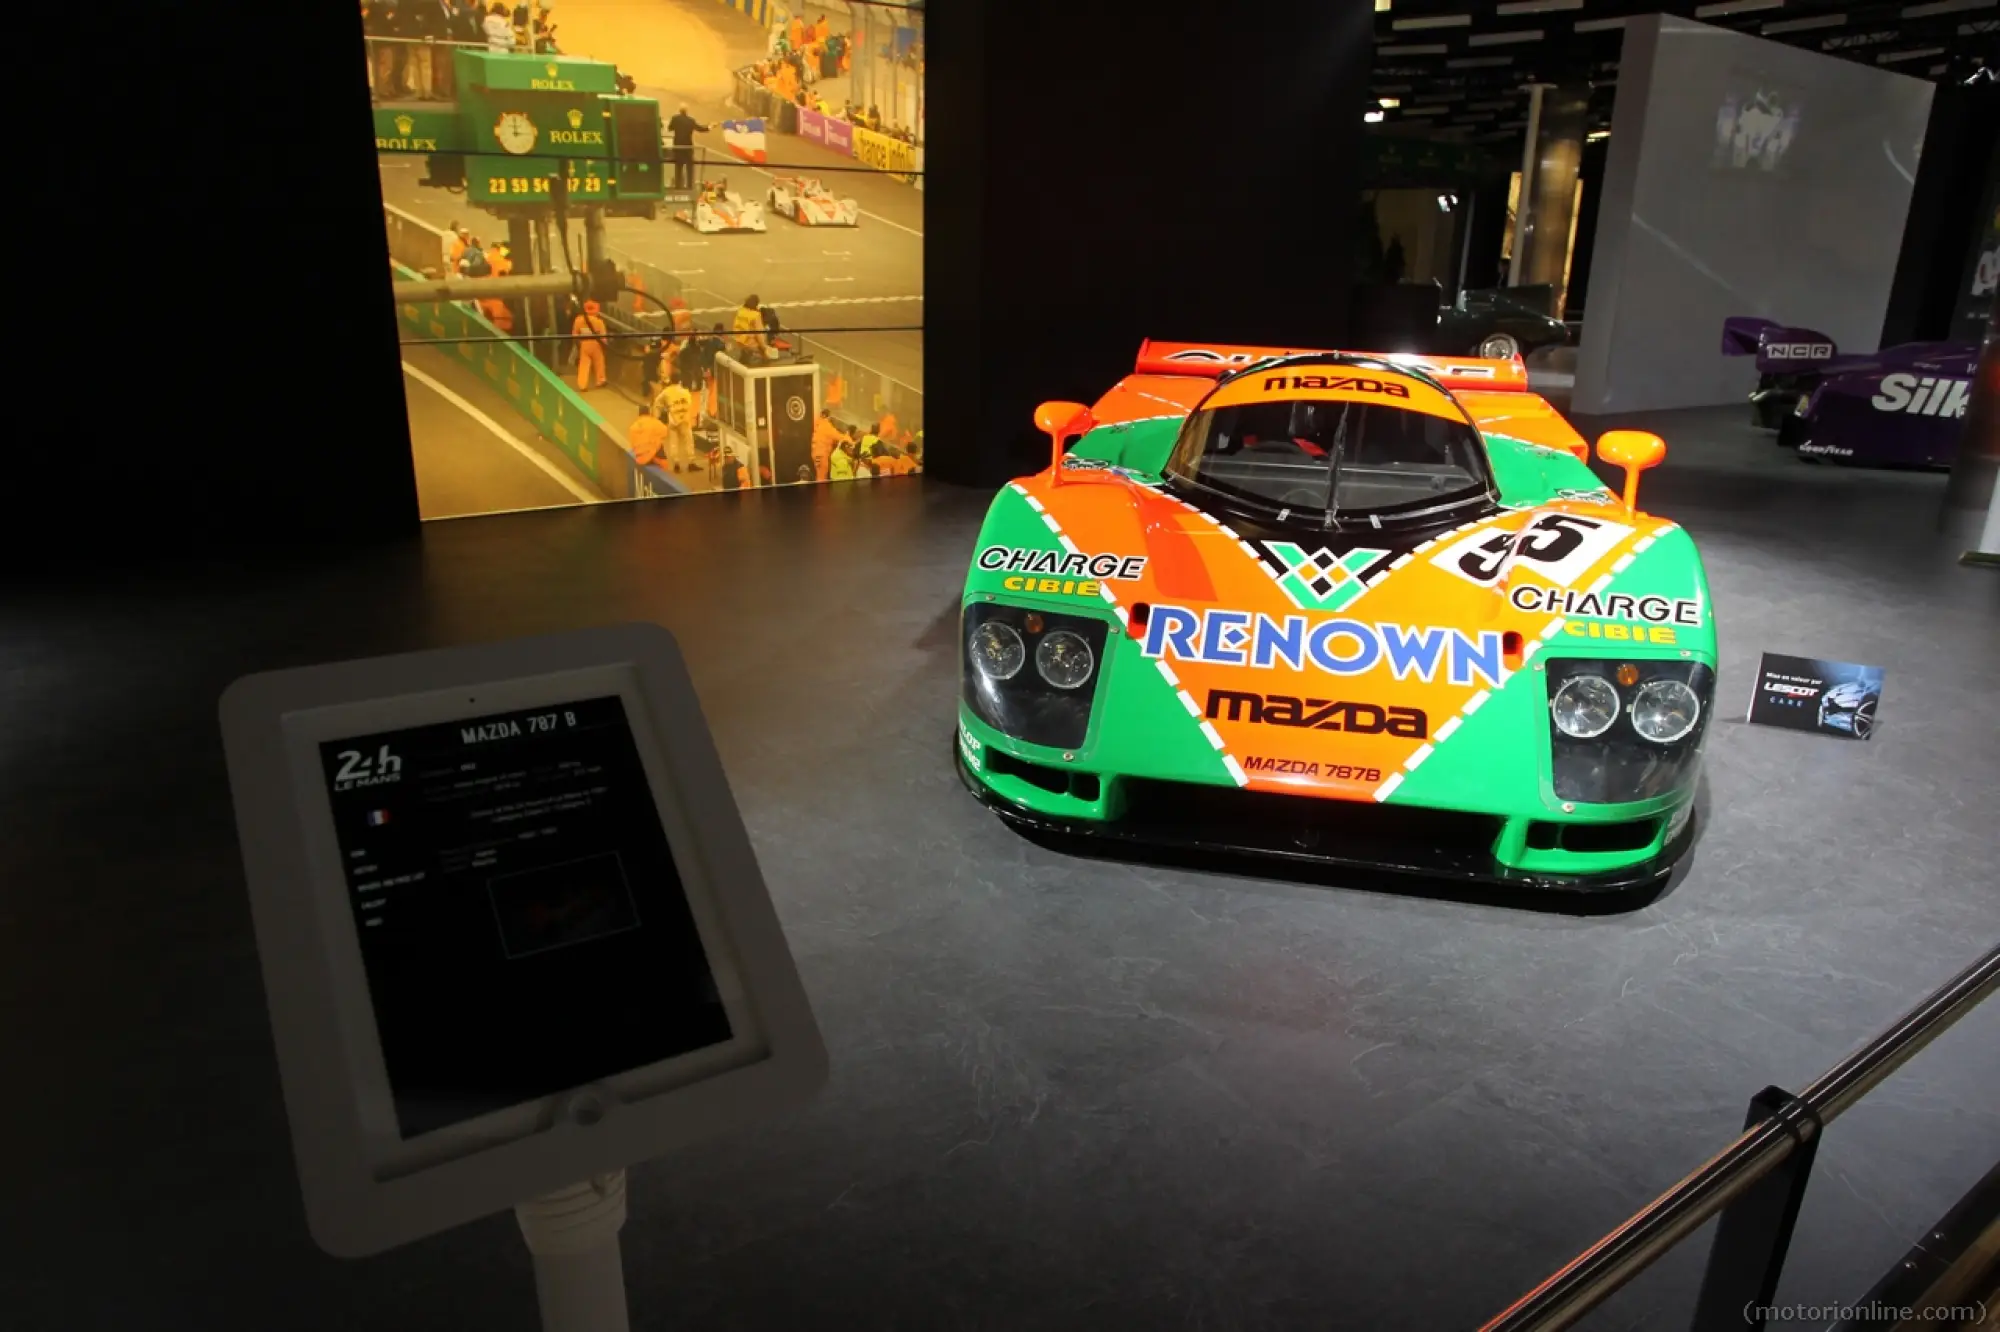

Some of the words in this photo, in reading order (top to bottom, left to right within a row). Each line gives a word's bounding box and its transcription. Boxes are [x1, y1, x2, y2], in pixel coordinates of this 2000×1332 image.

[531, 79, 575, 91] ROLEX
[376, 138, 437, 151] ROLEX
[550, 130, 604, 145] ROLEX
[1767, 344, 1832, 359] NCR
[1458, 514, 1601, 581] 55
[977, 545, 1149, 580] CHARGE
[1510, 585, 1701, 627] CHARGE
[1141, 603, 1505, 689] RENOWN
[461, 720, 522, 744] MAZDA
[527, 714, 558, 733] 787
[564, 711, 577, 727] B
[334, 779, 352, 792] LE
[356, 772, 402, 789] MANS
[1244, 756, 1319, 776] MAZDA
[1325, 763, 1381, 783] 787B
